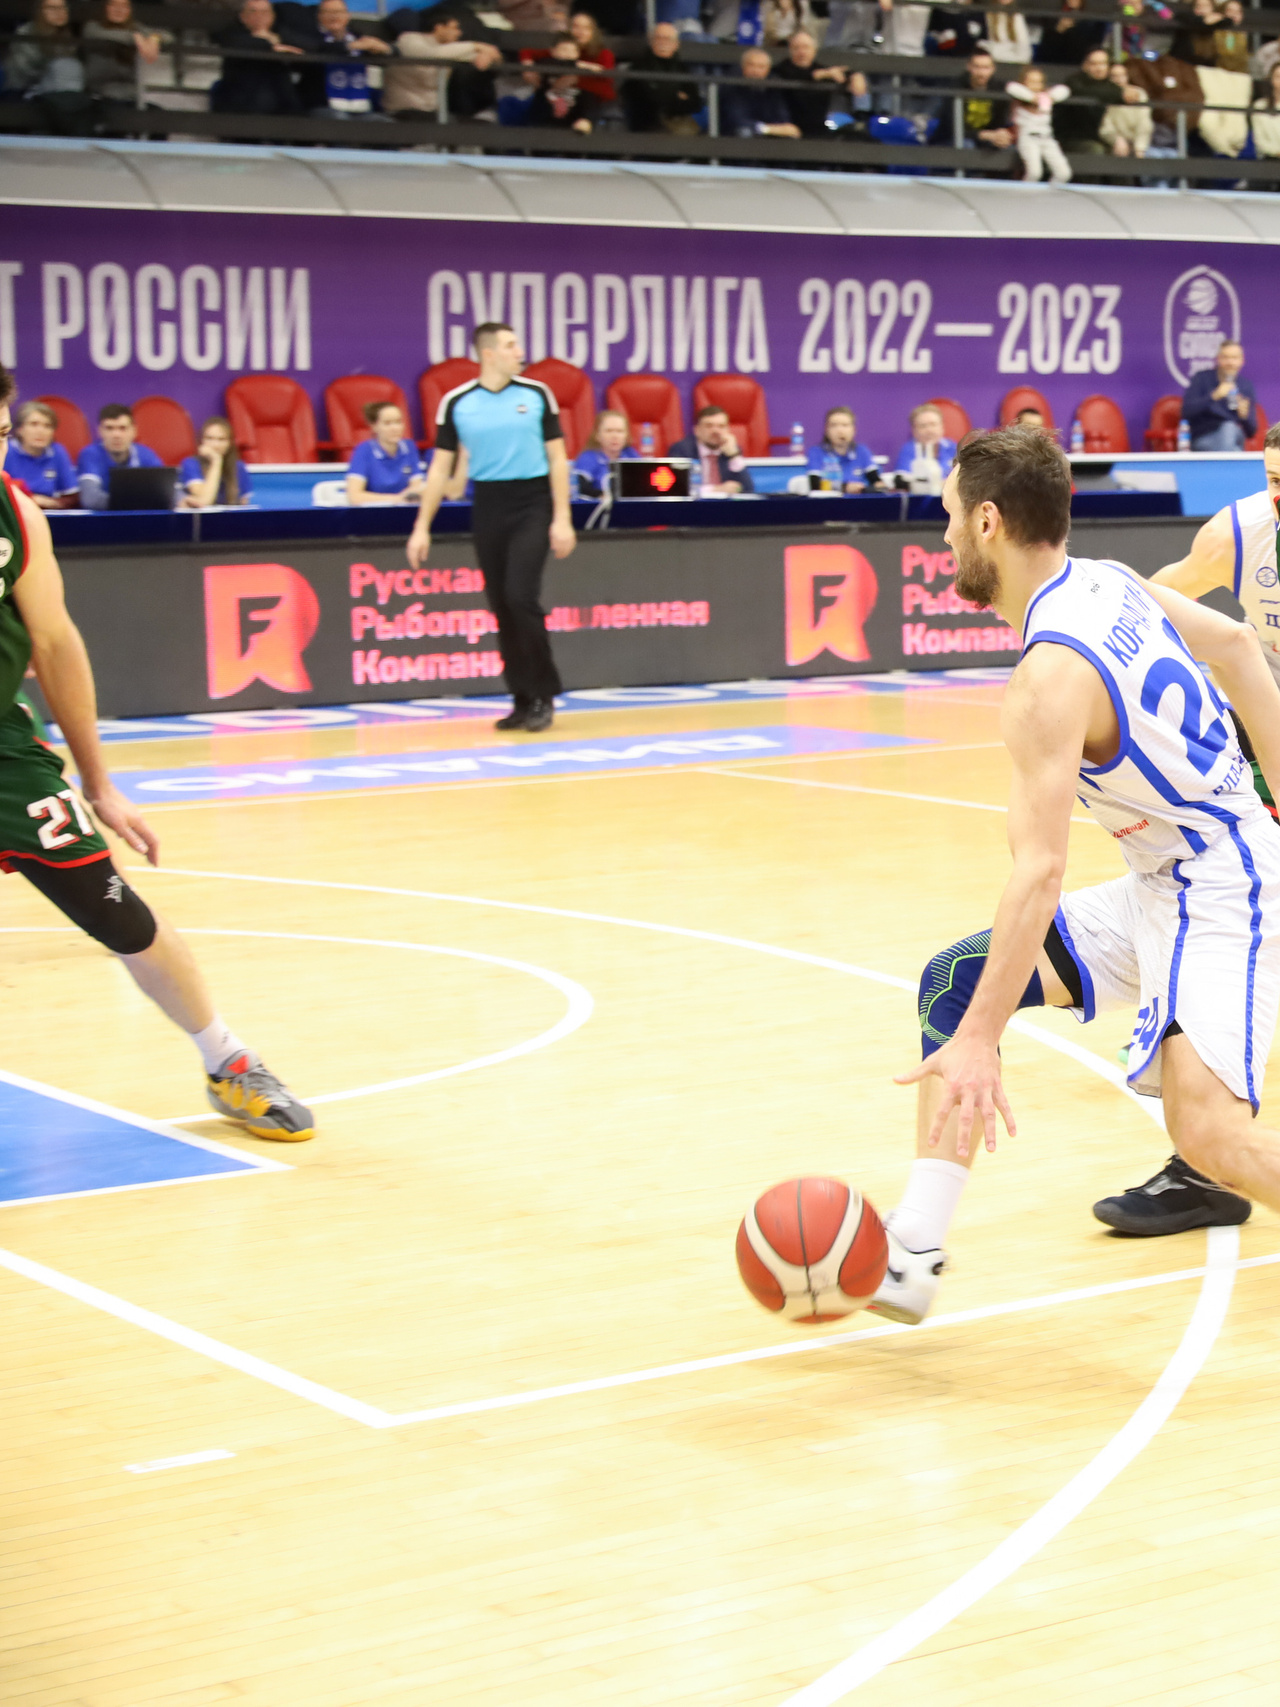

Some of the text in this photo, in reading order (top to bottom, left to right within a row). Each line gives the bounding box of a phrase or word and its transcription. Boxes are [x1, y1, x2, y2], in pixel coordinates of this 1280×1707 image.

[41, 261, 312, 371] РОССИИ
[902, 622, 1023, 655] Компан
[352, 650, 504, 684] Компан
